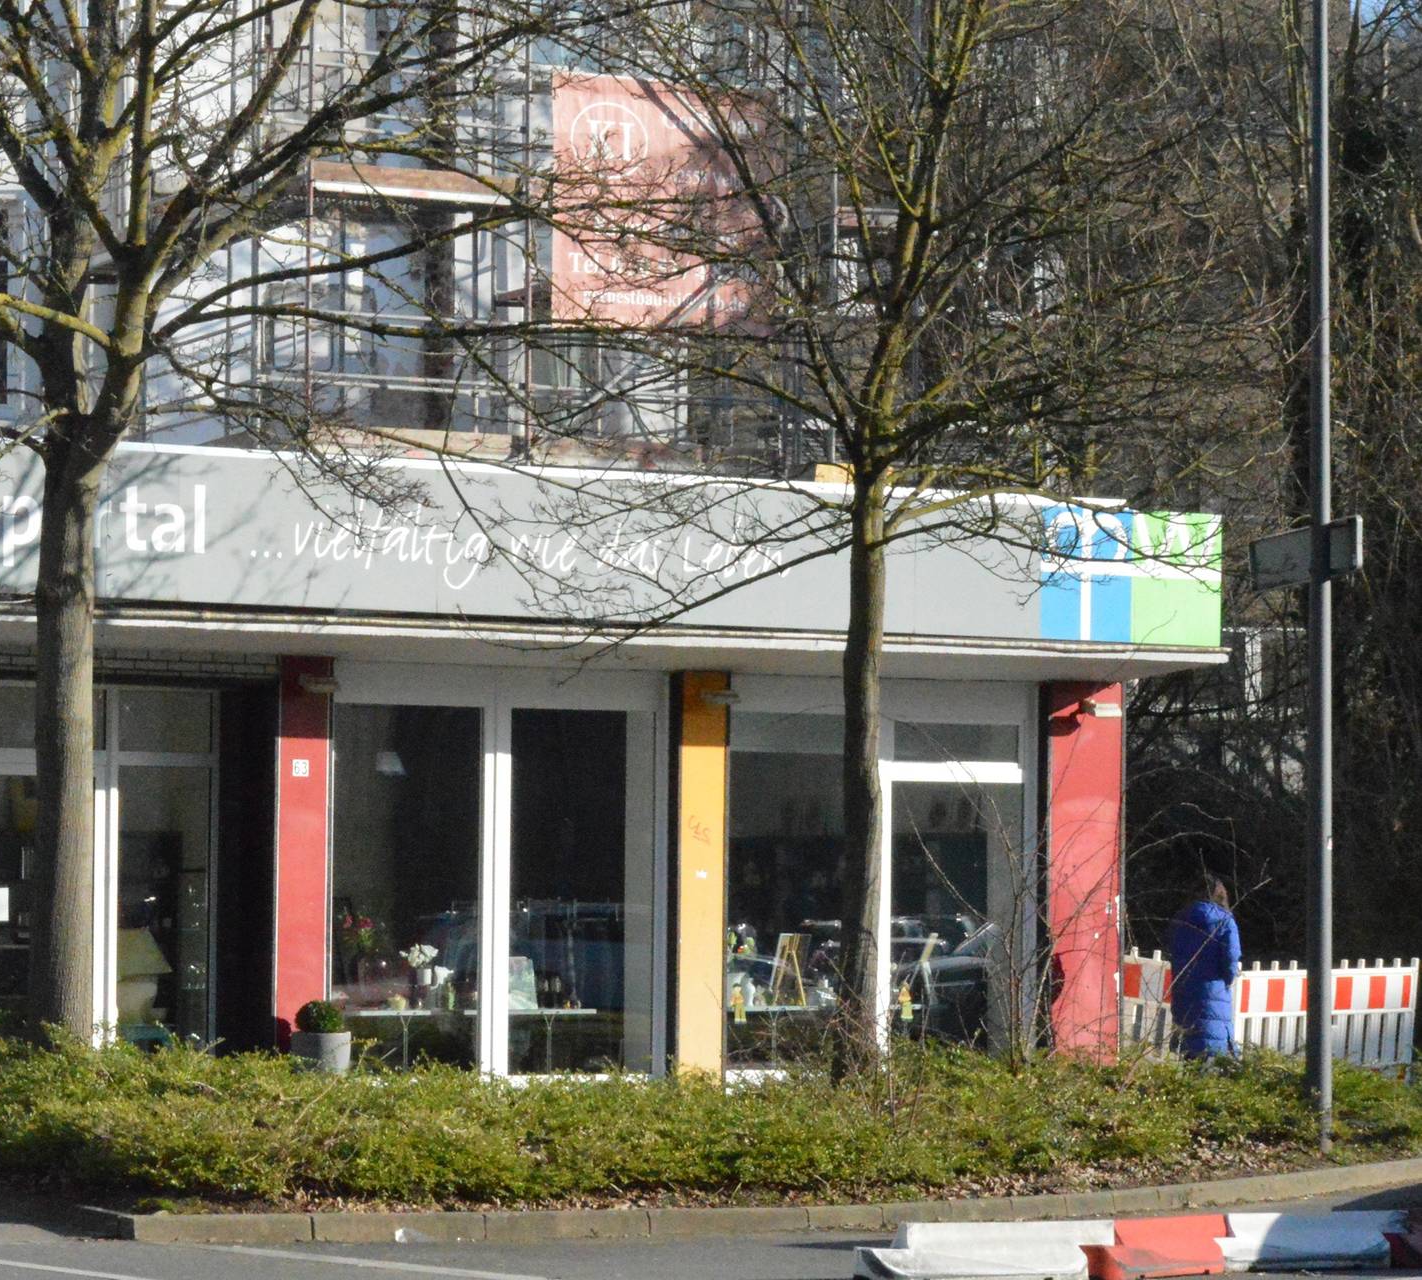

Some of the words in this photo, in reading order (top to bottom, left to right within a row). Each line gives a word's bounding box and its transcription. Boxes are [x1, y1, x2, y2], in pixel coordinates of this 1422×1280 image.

[509, 533, 579, 573] wie
[596, 521, 662, 576] das
[683, 515, 792, 579] Leben
